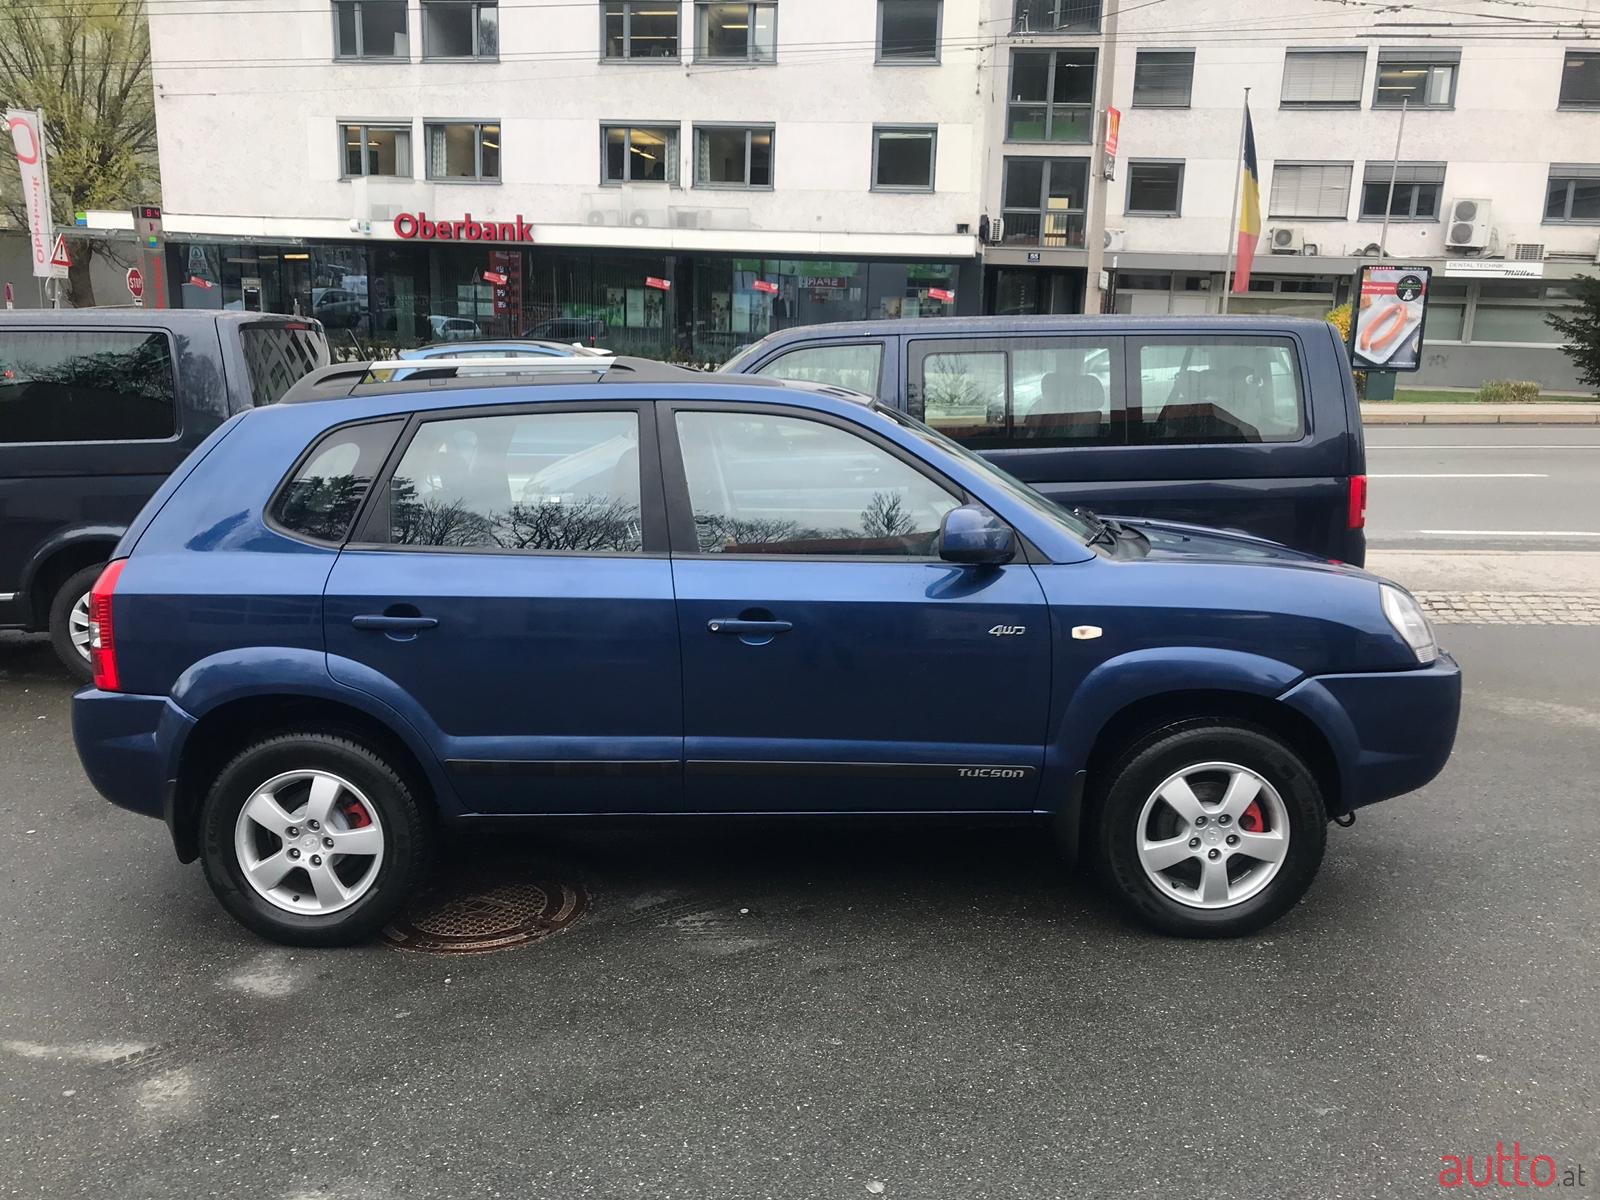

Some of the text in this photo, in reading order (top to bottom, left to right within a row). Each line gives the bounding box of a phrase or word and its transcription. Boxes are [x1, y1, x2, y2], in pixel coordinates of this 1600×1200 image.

[393, 211, 534, 243] Oberbank
[1504, 269, 1535, 277] Müller
[988, 624, 1026, 637] 4WD
[957, 768, 1025, 778] TUCSON
